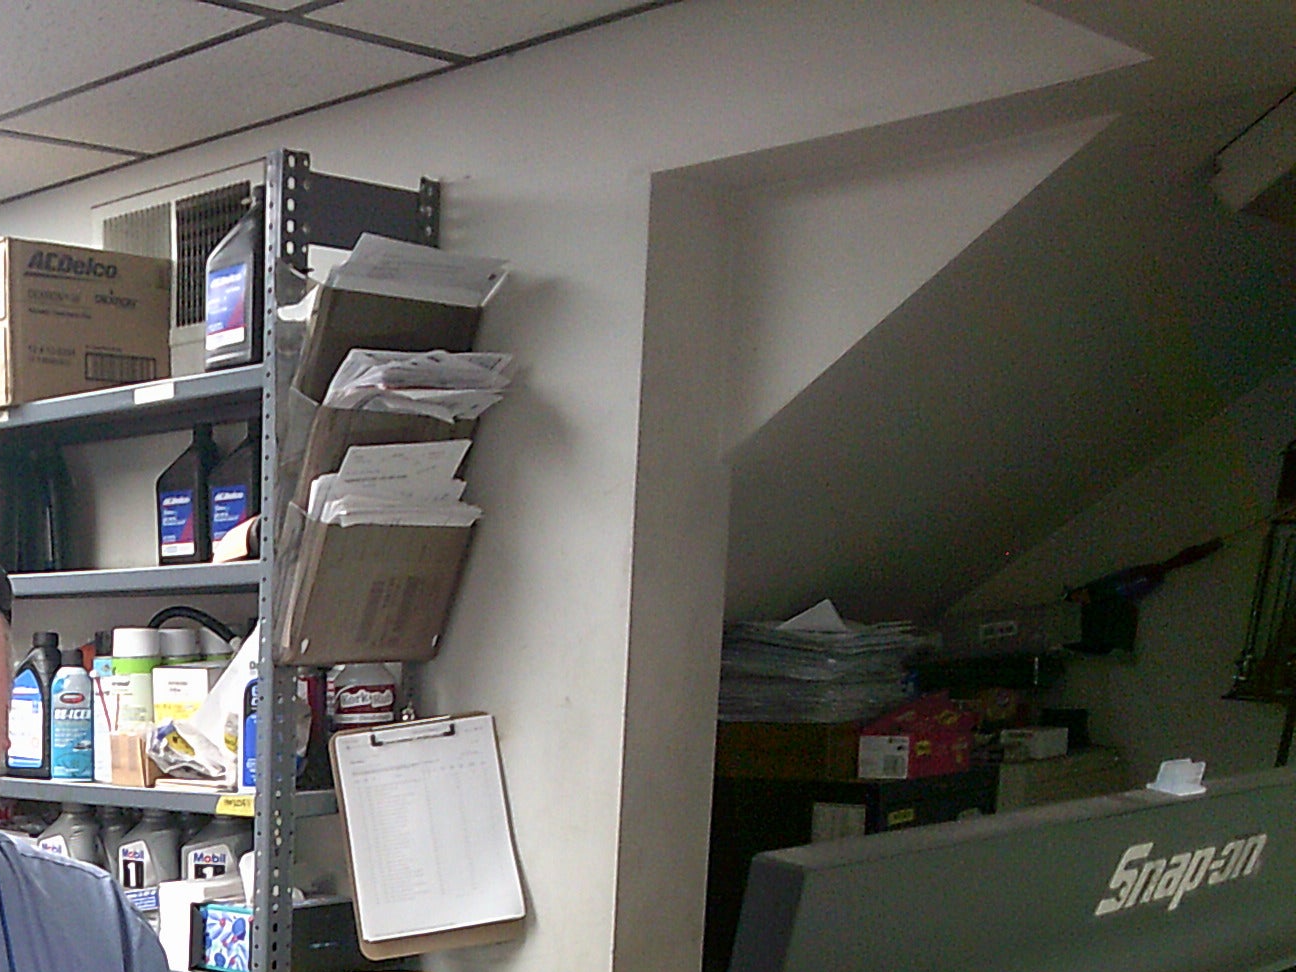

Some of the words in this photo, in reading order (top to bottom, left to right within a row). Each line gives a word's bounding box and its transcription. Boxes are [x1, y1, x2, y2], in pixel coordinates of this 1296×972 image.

[27, 251, 117, 278] ACDelco
[122, 848, 144, 859] Mobil
[193, 852, 226, 864] Mobil
[127, 862, 137, 887] 1
[1095, 834, 1267, 916] Snap-on
